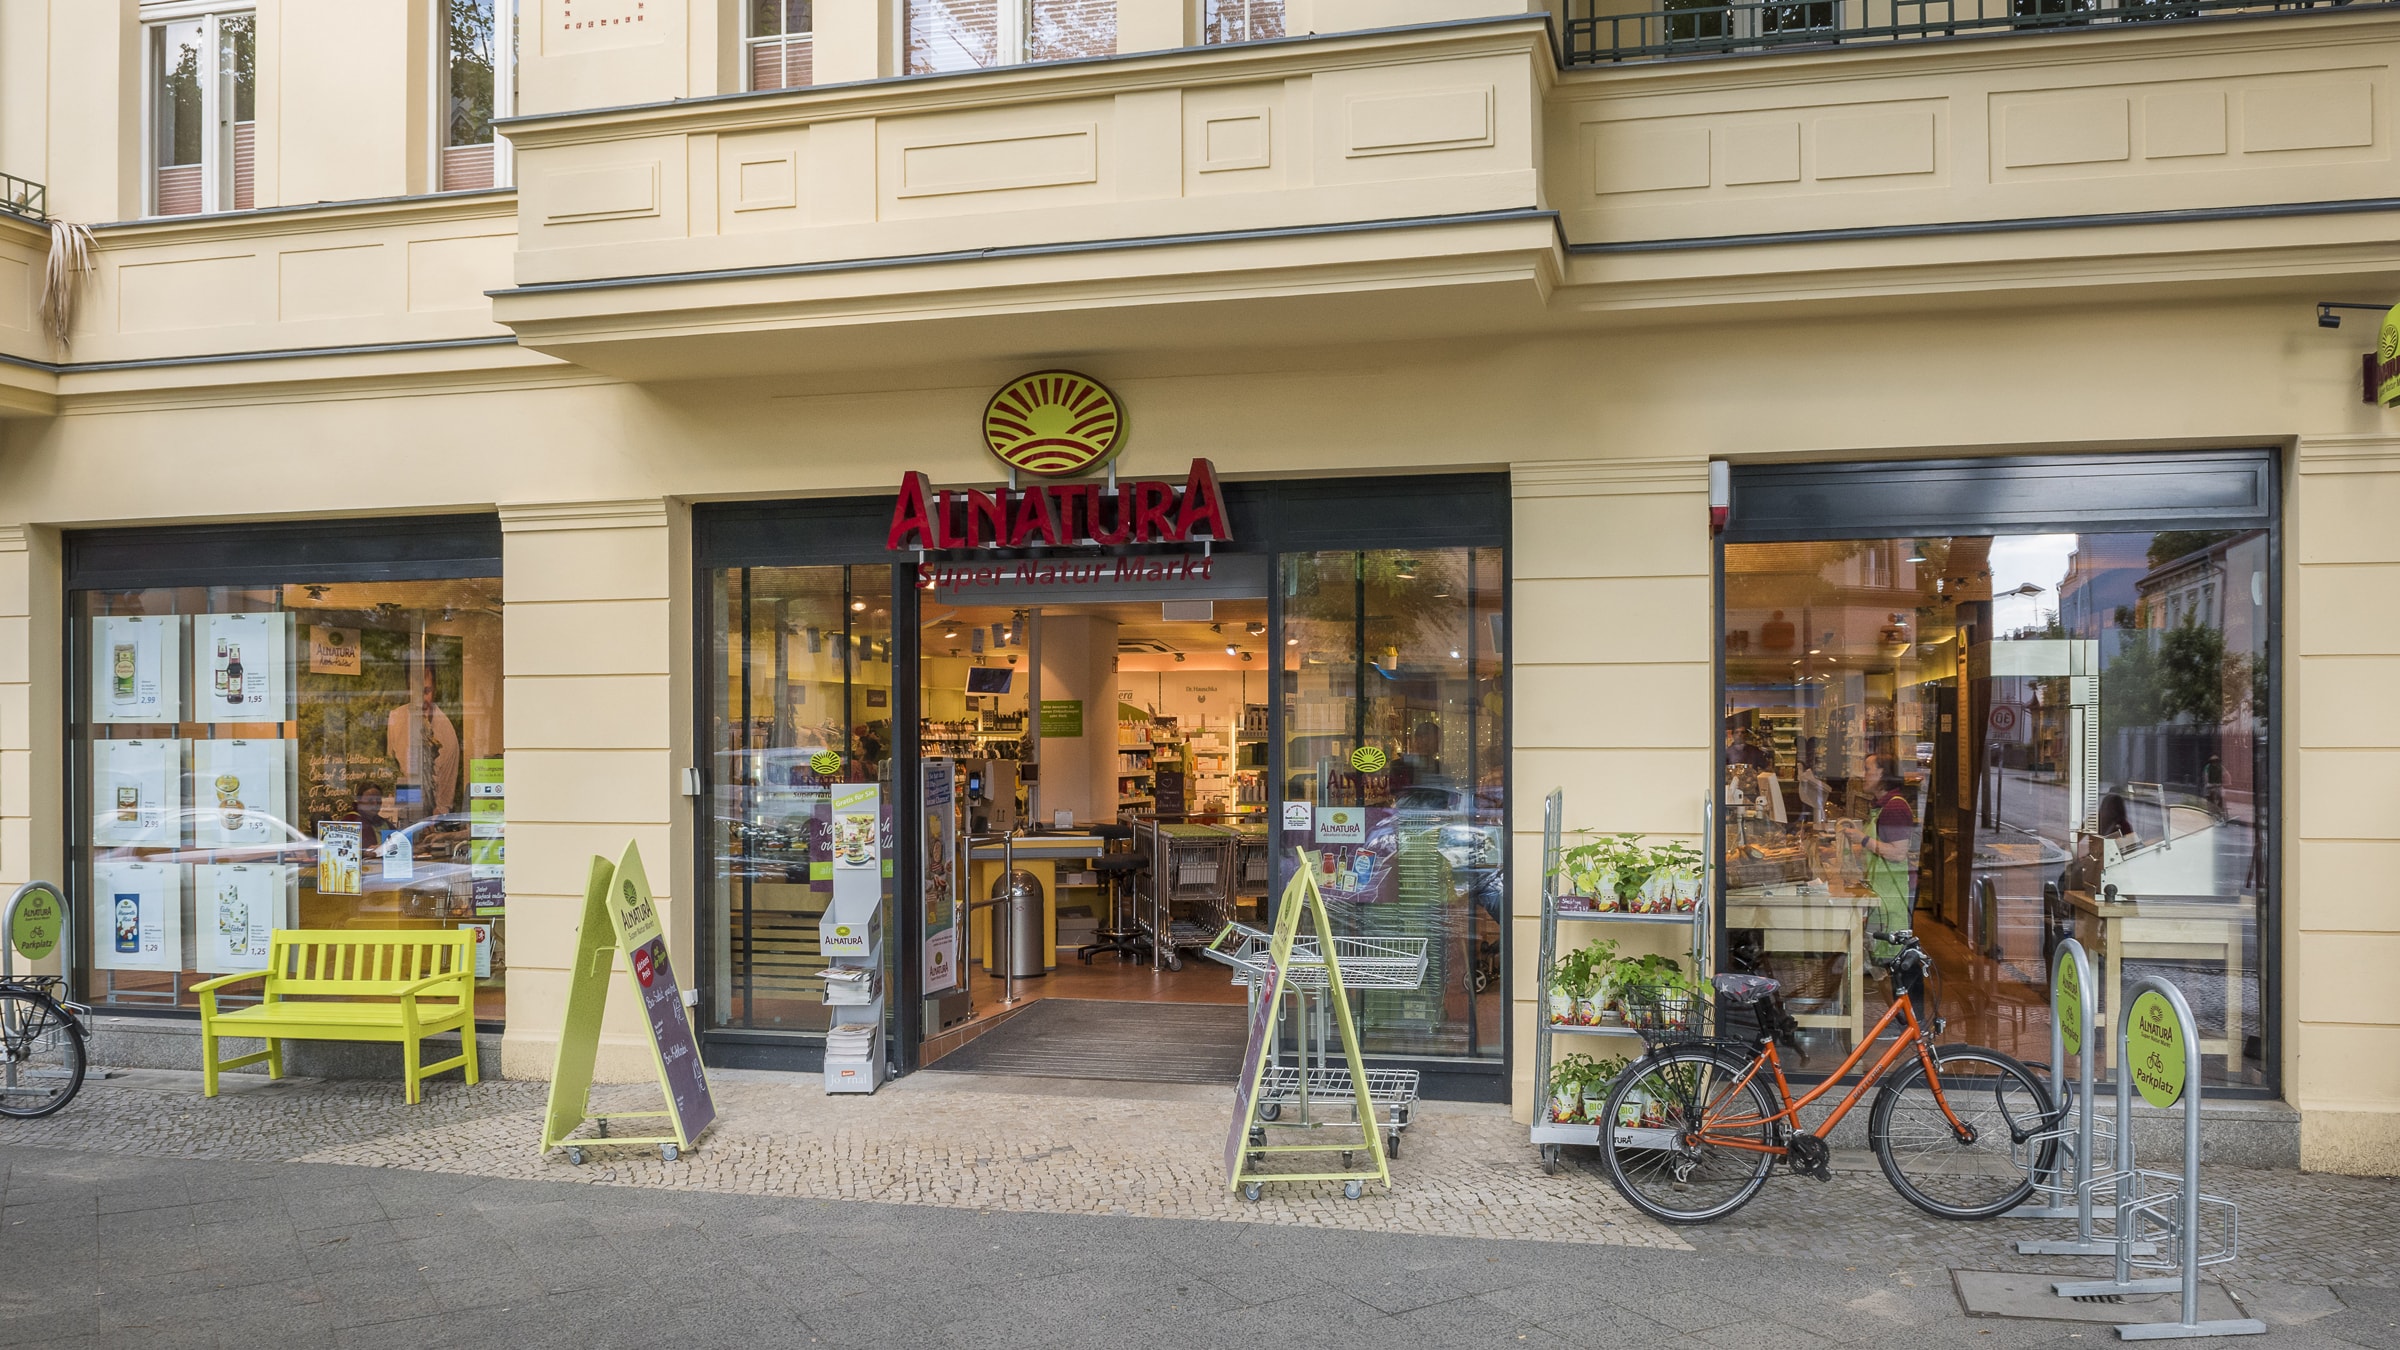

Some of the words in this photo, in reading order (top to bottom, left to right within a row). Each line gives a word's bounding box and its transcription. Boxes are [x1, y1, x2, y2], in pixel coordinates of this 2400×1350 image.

[887, 458, 1233, 550] ALNATURA
[916, 561, 1006, 593] Super
[1014, 559, 1107, 586] Natur
[1113, 554, 1214, 583] Markt
[248, 695, 262, 703] 1,95
[835, 798, 854, 808] Gratis
[855, 793, 865, 801] für
[1321, 823, 1360, 832] ALNATURA
[620, 897, 653, 931] ALNATURA
[21, 940, 52, 950] Parkplatz
[825, 936, 863, 945] ALNATURA
[145, 944, 158, 952] 1,29
[637, 955, 650, 972] Aktions
[642, 967, 651, 981] Preis
[2139, 1016, 2173, 1042] ALNATURA
[2137, 1068, 2173, 1094] Parkplatz
[1589, 1103, 1602, 1111] BIO
[1621, 1106, 1634, 1114] BIO
